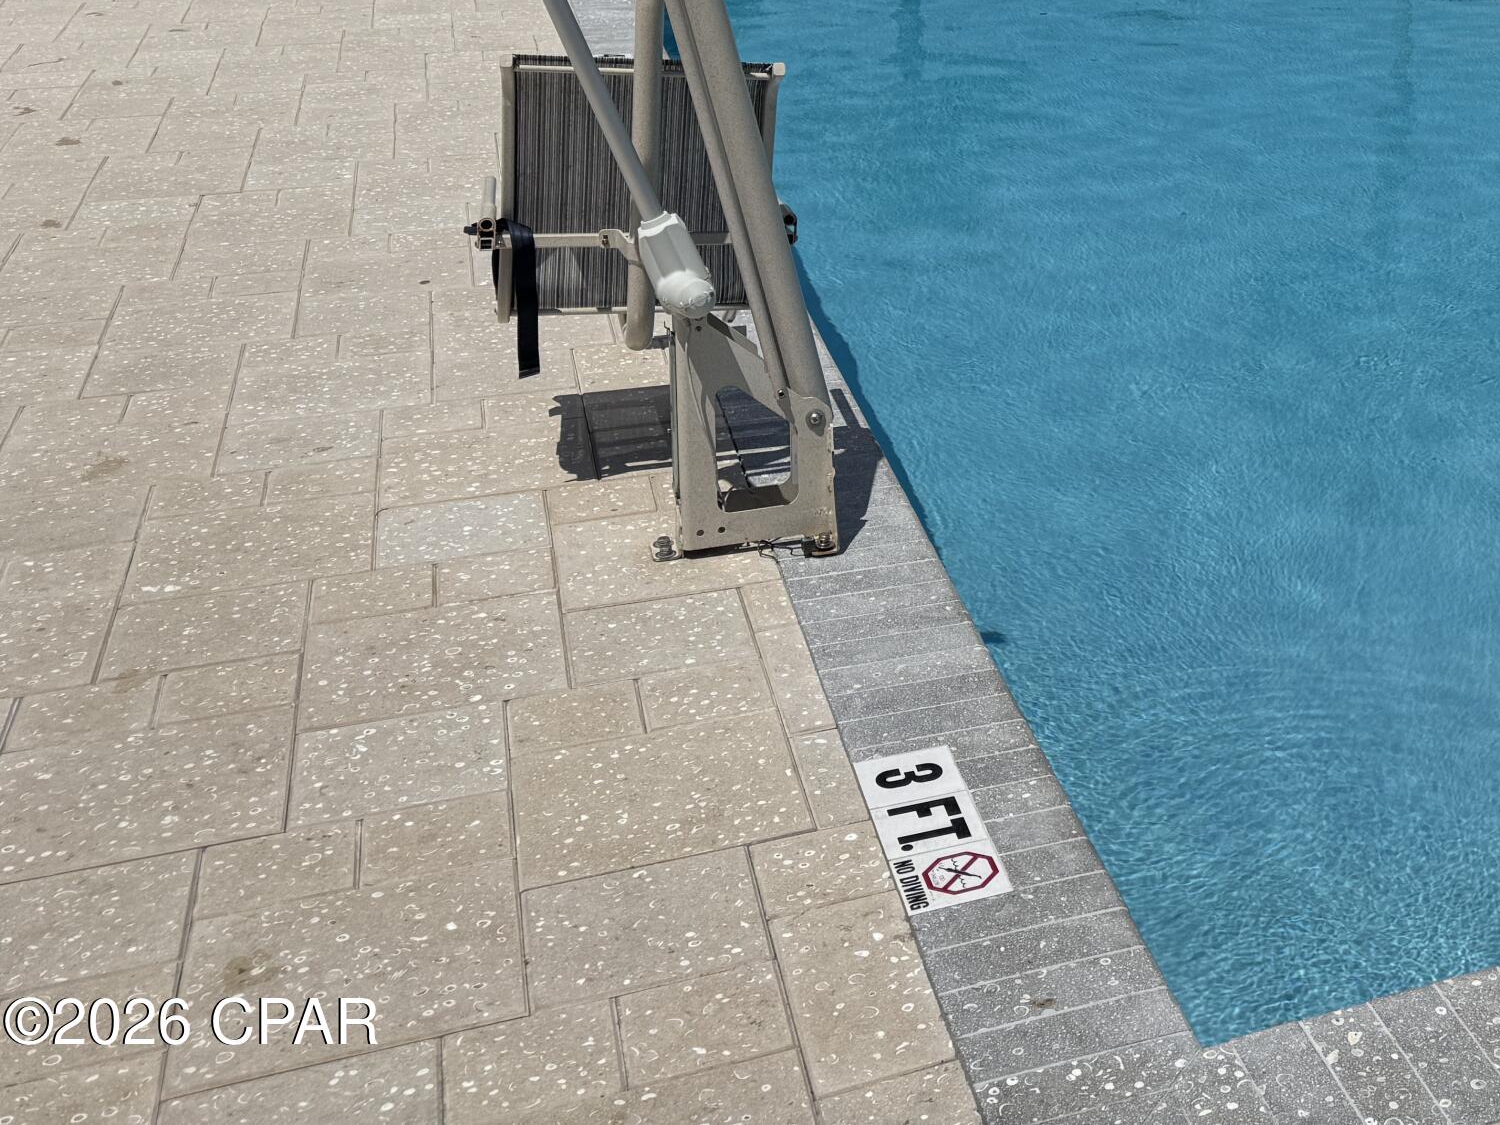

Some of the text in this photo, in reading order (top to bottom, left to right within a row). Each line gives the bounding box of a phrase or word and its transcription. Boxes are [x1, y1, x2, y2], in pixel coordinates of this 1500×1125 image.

[875, 762, 972, 852] 3 FT.
[893, 859, 930, 911] NO DIVING
